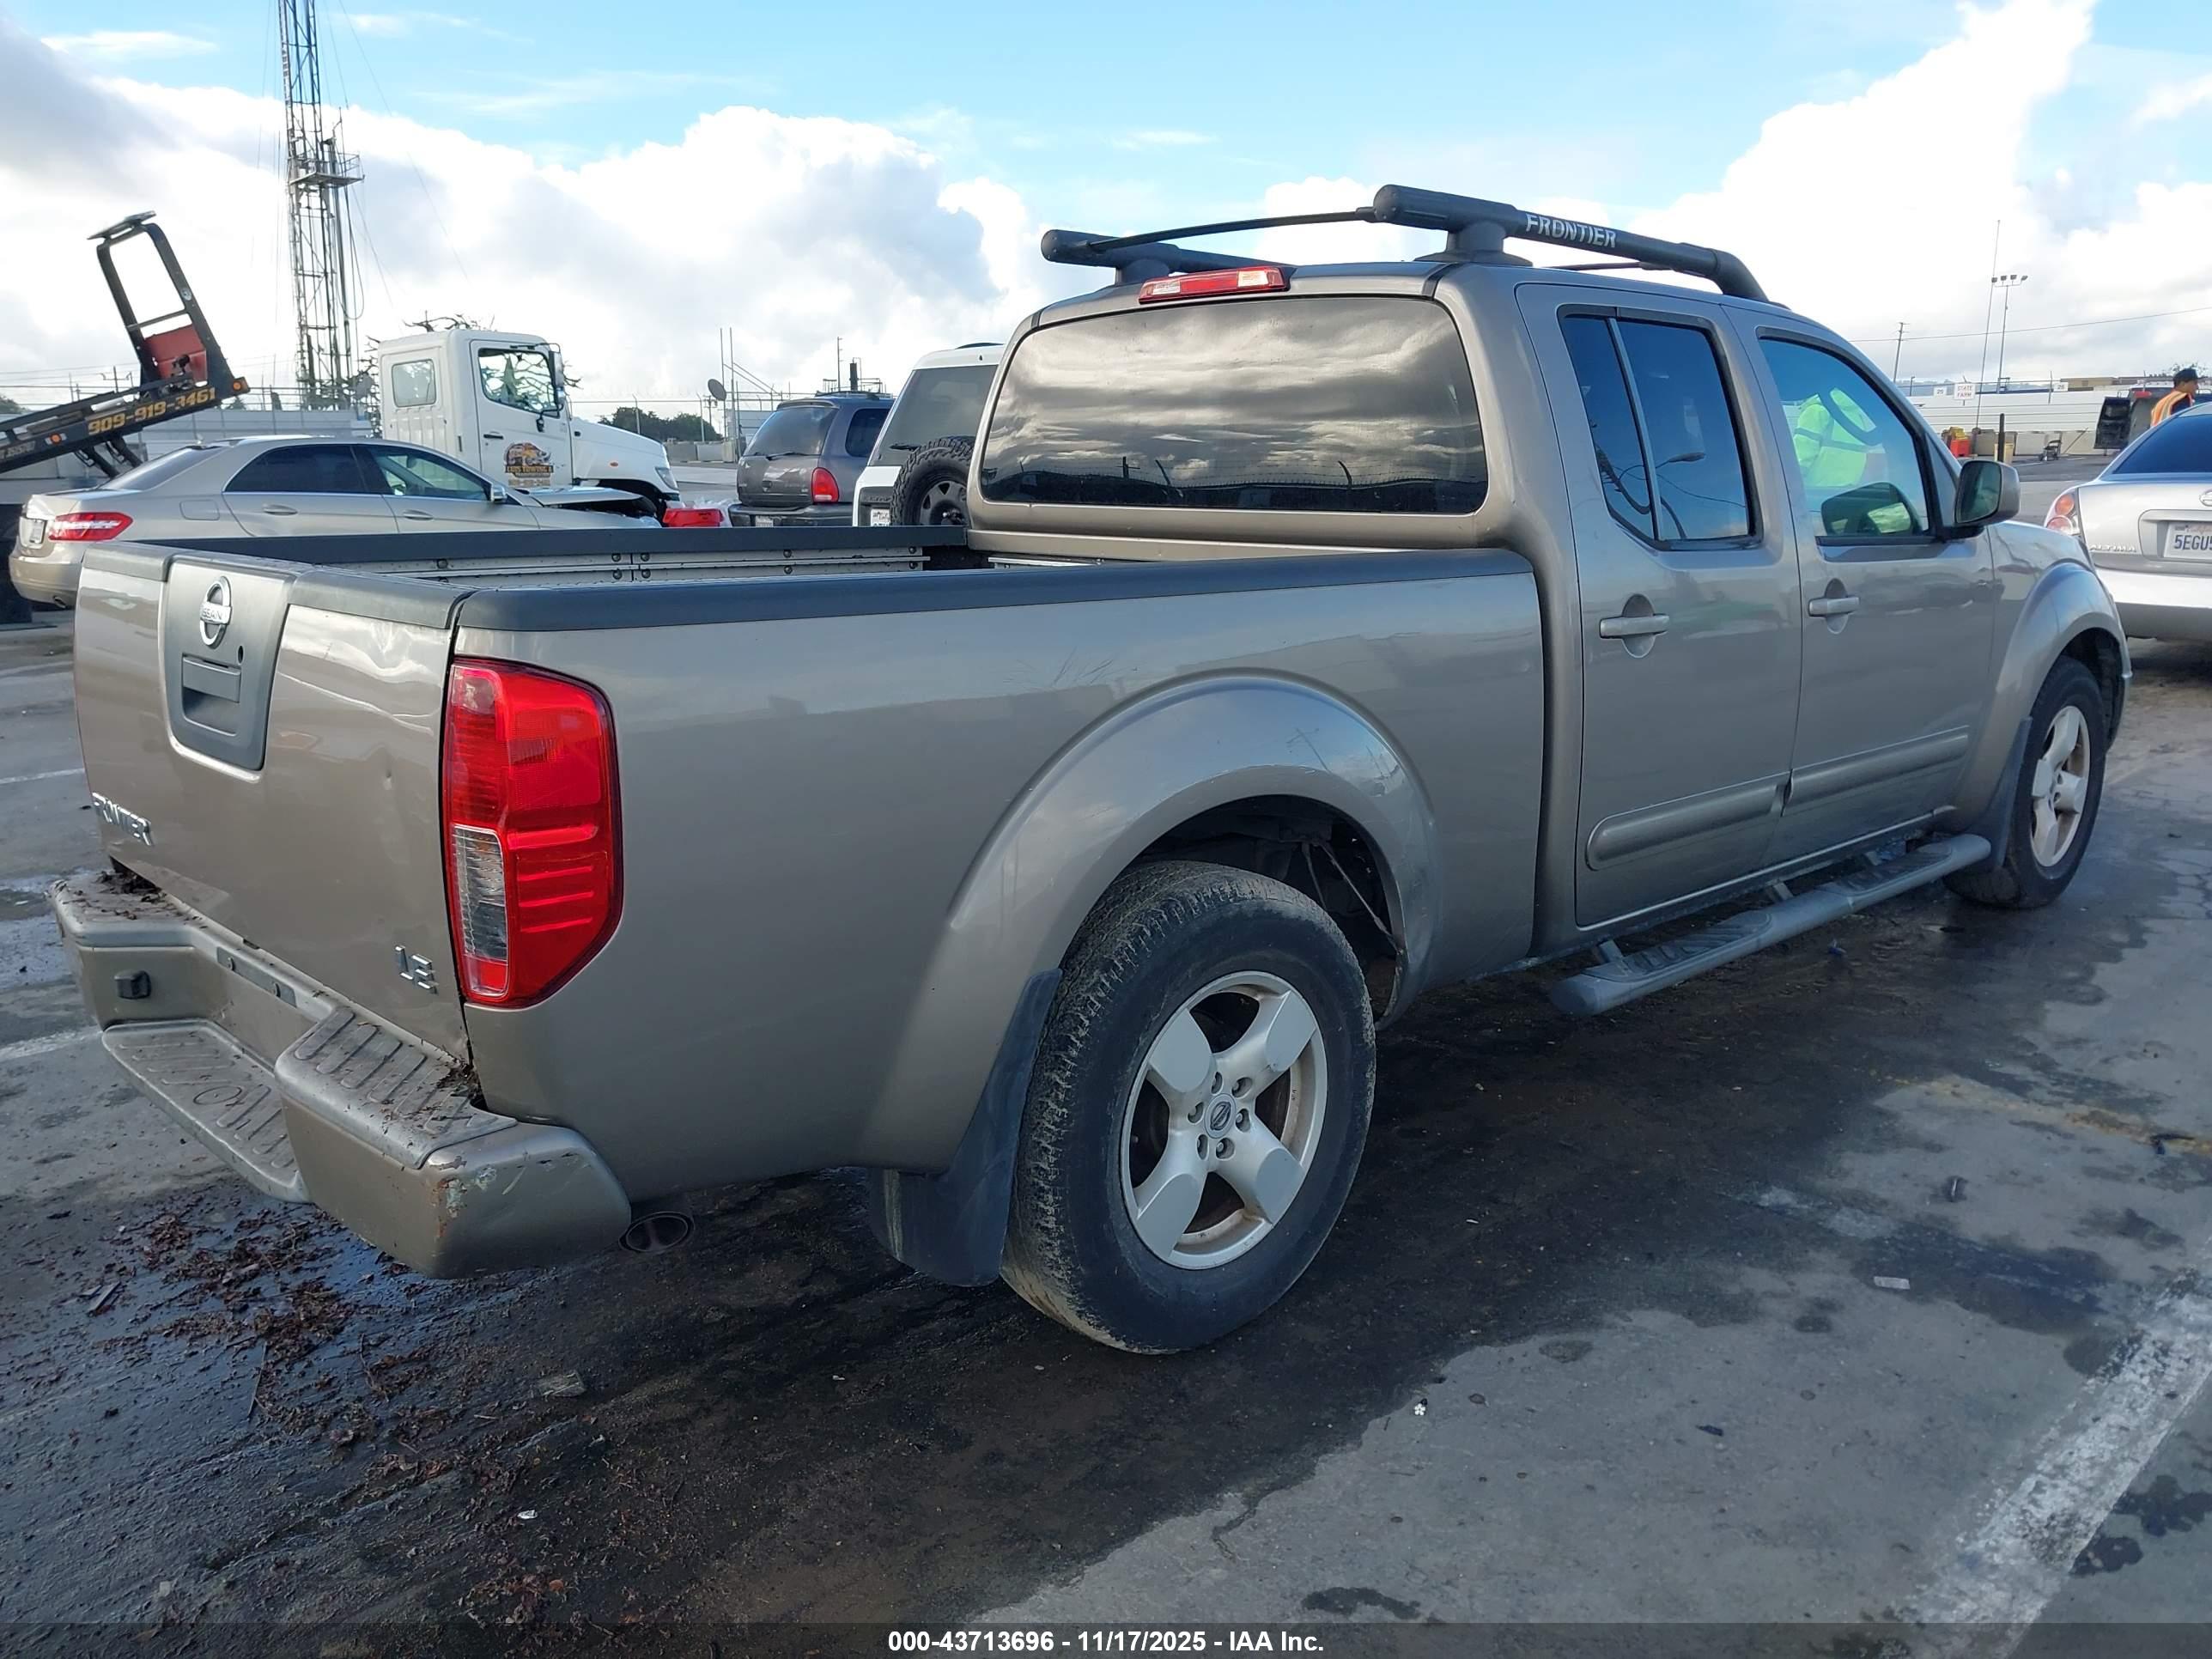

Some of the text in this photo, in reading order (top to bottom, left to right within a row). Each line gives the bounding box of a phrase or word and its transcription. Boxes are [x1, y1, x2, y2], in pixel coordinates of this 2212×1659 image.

[1525, 213, 1616, 248] FRONTIER
[88, 387, 216, 436] 909-919-3461
[2089, 544, 2137, 553] ALTIMA
[395, 944, 439, 994] LE
